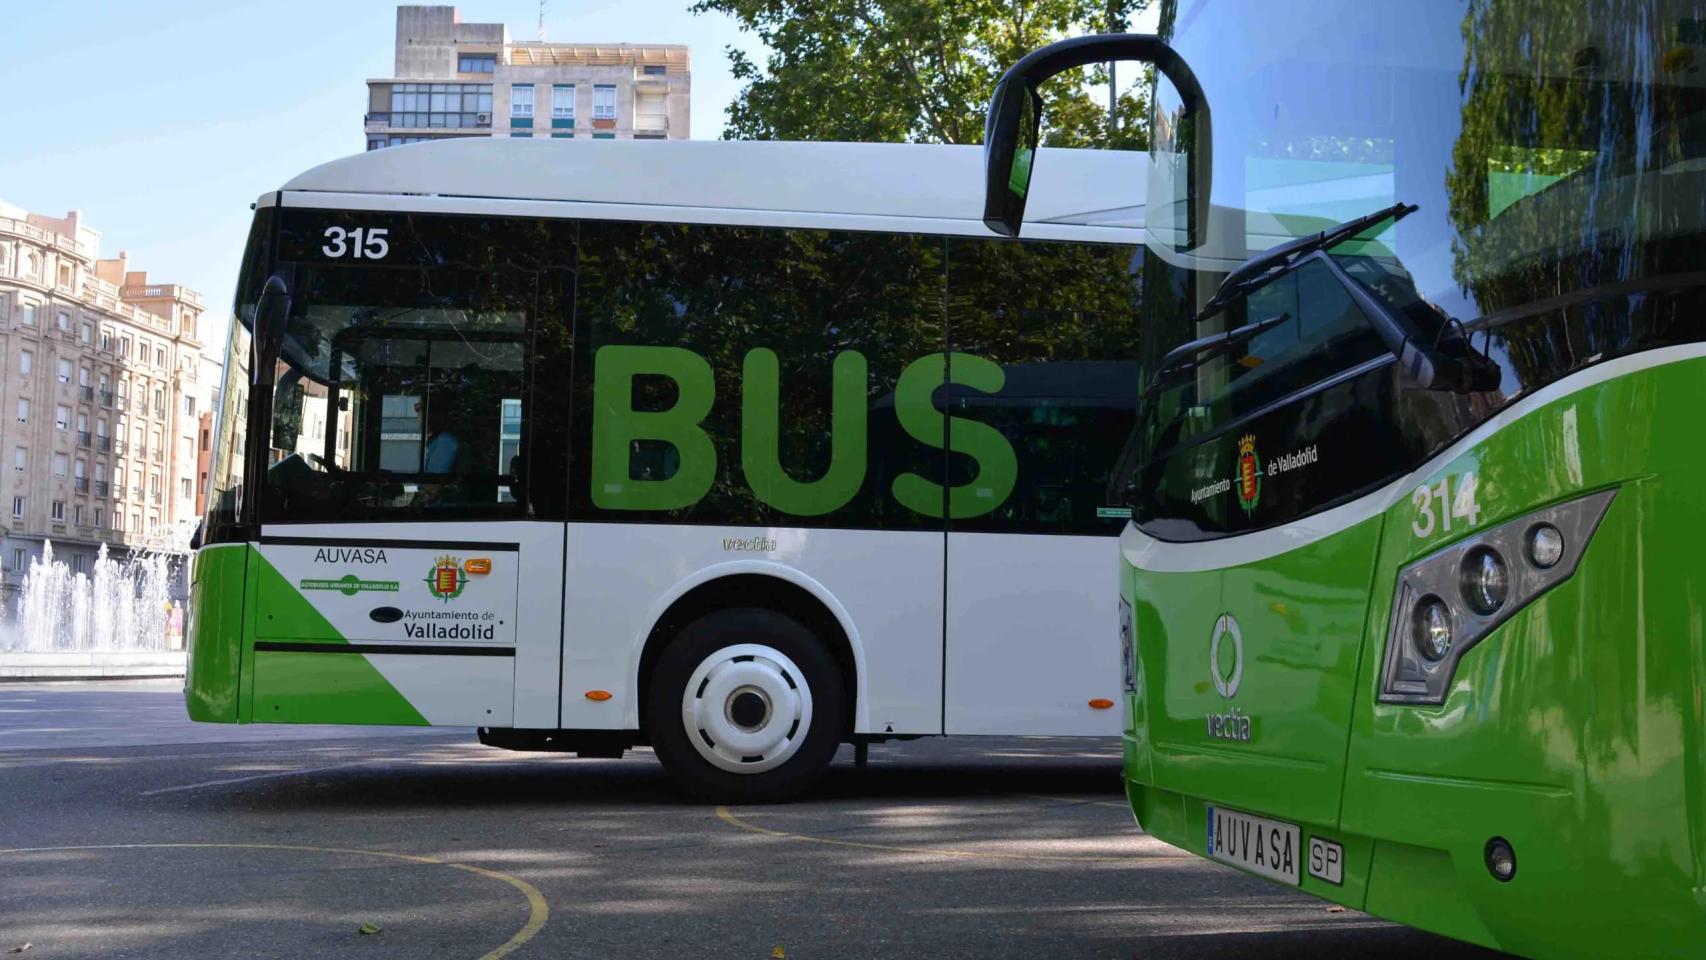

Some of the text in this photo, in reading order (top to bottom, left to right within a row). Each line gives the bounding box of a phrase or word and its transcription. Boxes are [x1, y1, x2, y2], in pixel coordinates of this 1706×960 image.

[322, 226, 389, 259] 315
[591, 345, 1018, 519] BUS
[1190, 444, 1318, 504] Ayuntamiento de Valladolid
[1411, 471, 1481, 538] 314
[314, 548, 388, 564] AUVASA
[723, 536, 777, 551] vectia
[404, 609, 495, 621] Ayuntamiento de
[404, 622, 494, 640] Valladolid
[1206, 706, 1251, 740] vectia
[1215, 814, 1294, 875] AUVASA
[1312, 843, 1338, 876] SP
